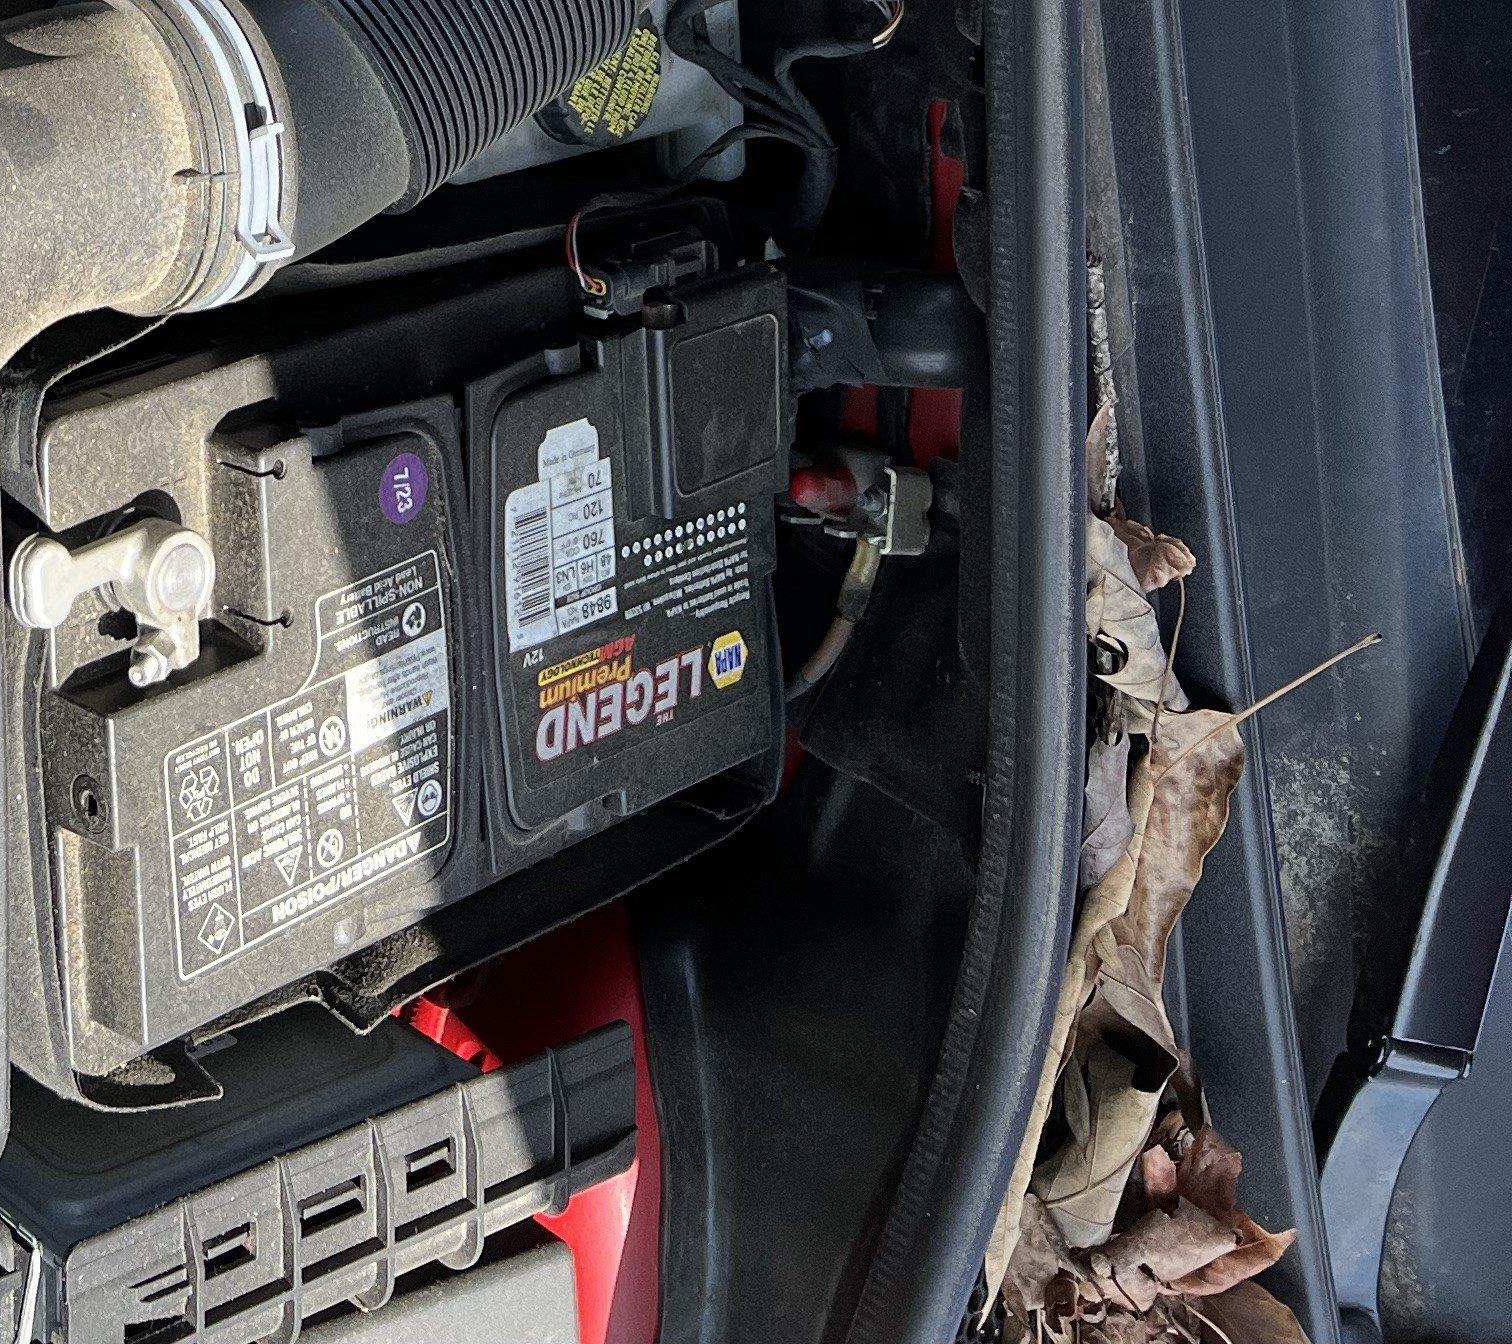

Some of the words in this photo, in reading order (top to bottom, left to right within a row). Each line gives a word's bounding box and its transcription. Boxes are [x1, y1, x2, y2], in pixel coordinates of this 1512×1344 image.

[542, 455, 559, 467] Made
[567, 442, 595, 457] Germany
[415, 456, 426, 477] 7/23
[588, 470, 600, 489] 70
[583, 499, 602, 519] 120
[583, 528, 604, 550] 760
[395, 565, 416, 584] Lead
[556, 566, 574, 584] LN3
[580, 559, 593, 575] H6
[339, 582, 371, 607] Battery
[374, 575, 393, 593] Acid
[335, 575, 422, 625] NON-SPILLABLE
[582, 594, 610, 619] 9848
[375, 627, 398, 646] READ
[600, 633, 635, 661] AGM
[522, 647, 543, 667] 12V
[540, 648, 598, 682] TECHNOLOGY
[715, 643, 741, 675] NAPA
[538, 654, 632, 714] Premium
[533, 644, 705, 764] LEGEND
[289, 716, 313, 738] REACH
[424, 718, 436, 733] OR
[655, 708, 673, 725] THE
[231, 727, 263, 757] OPEN.
[290, 736, 304, 754] THE
[304, 731, 316, 747] OF
[400, 738, 421, 758] CAUSE
[423, 732, 436, 746] CAN
[175, 759, 191, 774] MUST
[239, 747, 260, 772] NOT
[282, 756, 297, 775] OUT
[299, 747, 317, 768] KEEP
[397, 743, 437, 775] EXPLOSIVE
[243, 764, 259, 789] DO
[413, 760, 438, 784] SHIELD
[271, 784, 298, 807] SEVERE
[286, 812, 300, 830] CAN
[339, 802, 351, 821] NO
[208, 819, 227, 838] HELP
[261, 820, 284, 843] CAUSE
[214, 831, 228, 849] GET
[179, 839, 212, 866] MEDICAL
[210, 853, 230, 873] WITH
[241, 847, 261, 869] ACID
[182, 866, 231, 901] IMMEDIATELY
[208, 879, 231, 901] FLUSH
[272, 835, 406, 927] DANGER/POISON
[188, 891, 206, 912] EYES
